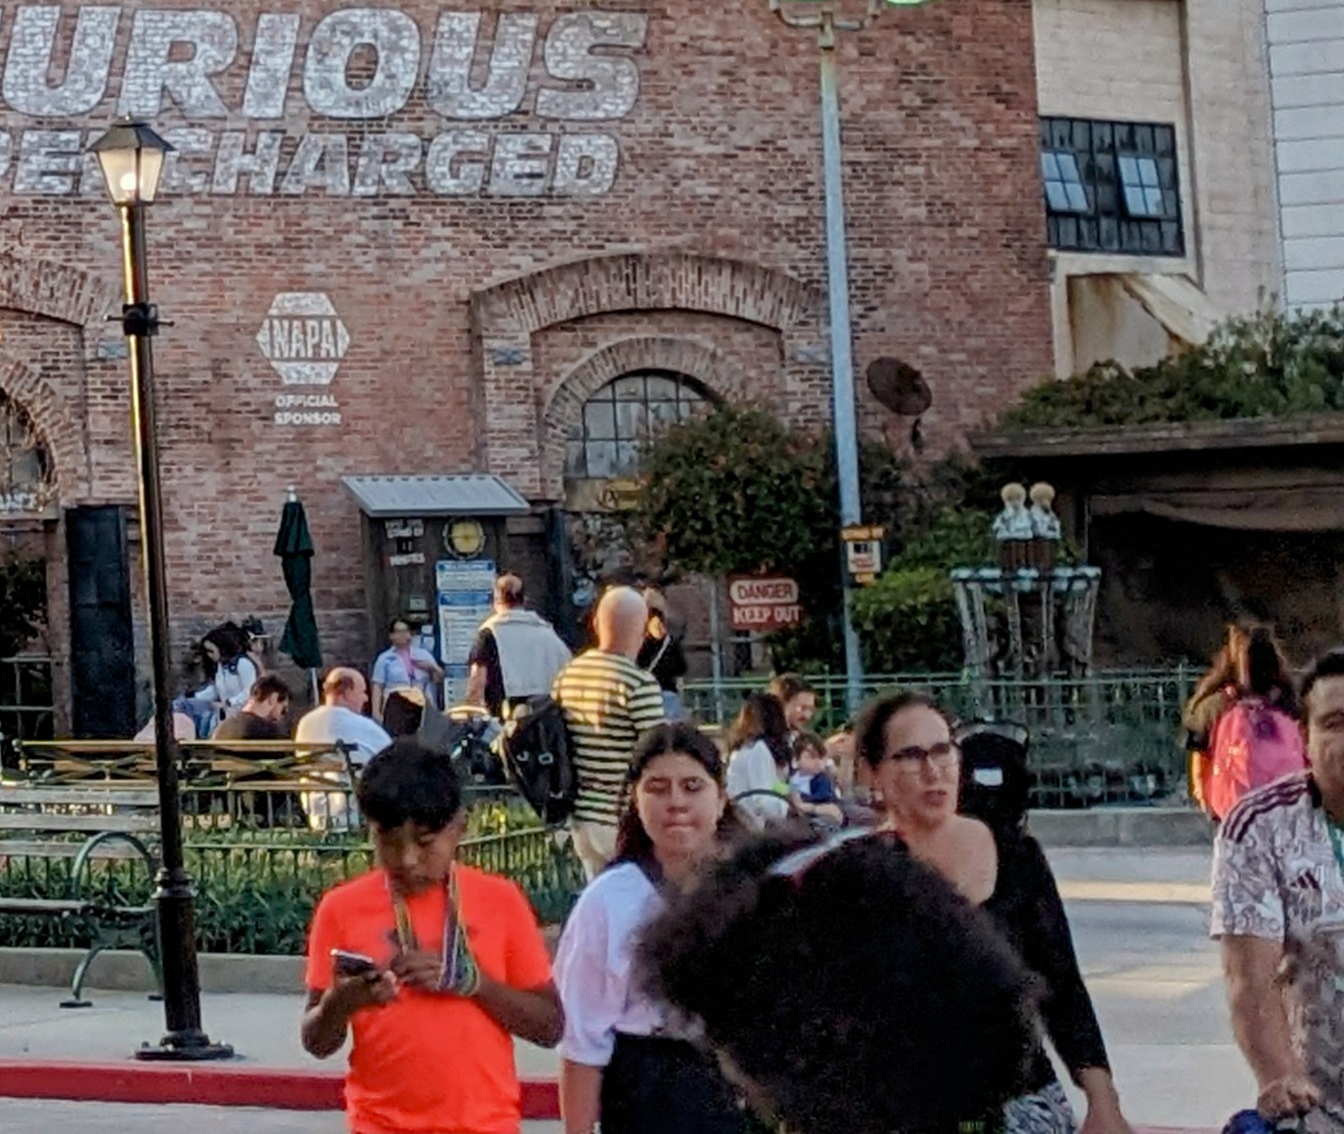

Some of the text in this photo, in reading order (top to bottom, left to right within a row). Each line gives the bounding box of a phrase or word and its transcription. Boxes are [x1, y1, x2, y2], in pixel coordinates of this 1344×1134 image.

[272, 318, 337, 358] NAPA
[275, 394, 340, 408] OFFICIAL
[273, 412, 342, 425] SPONSOR
[737, 583, 794, 599] DANGER
[733, 605, 803, 624] KEEP OUT
